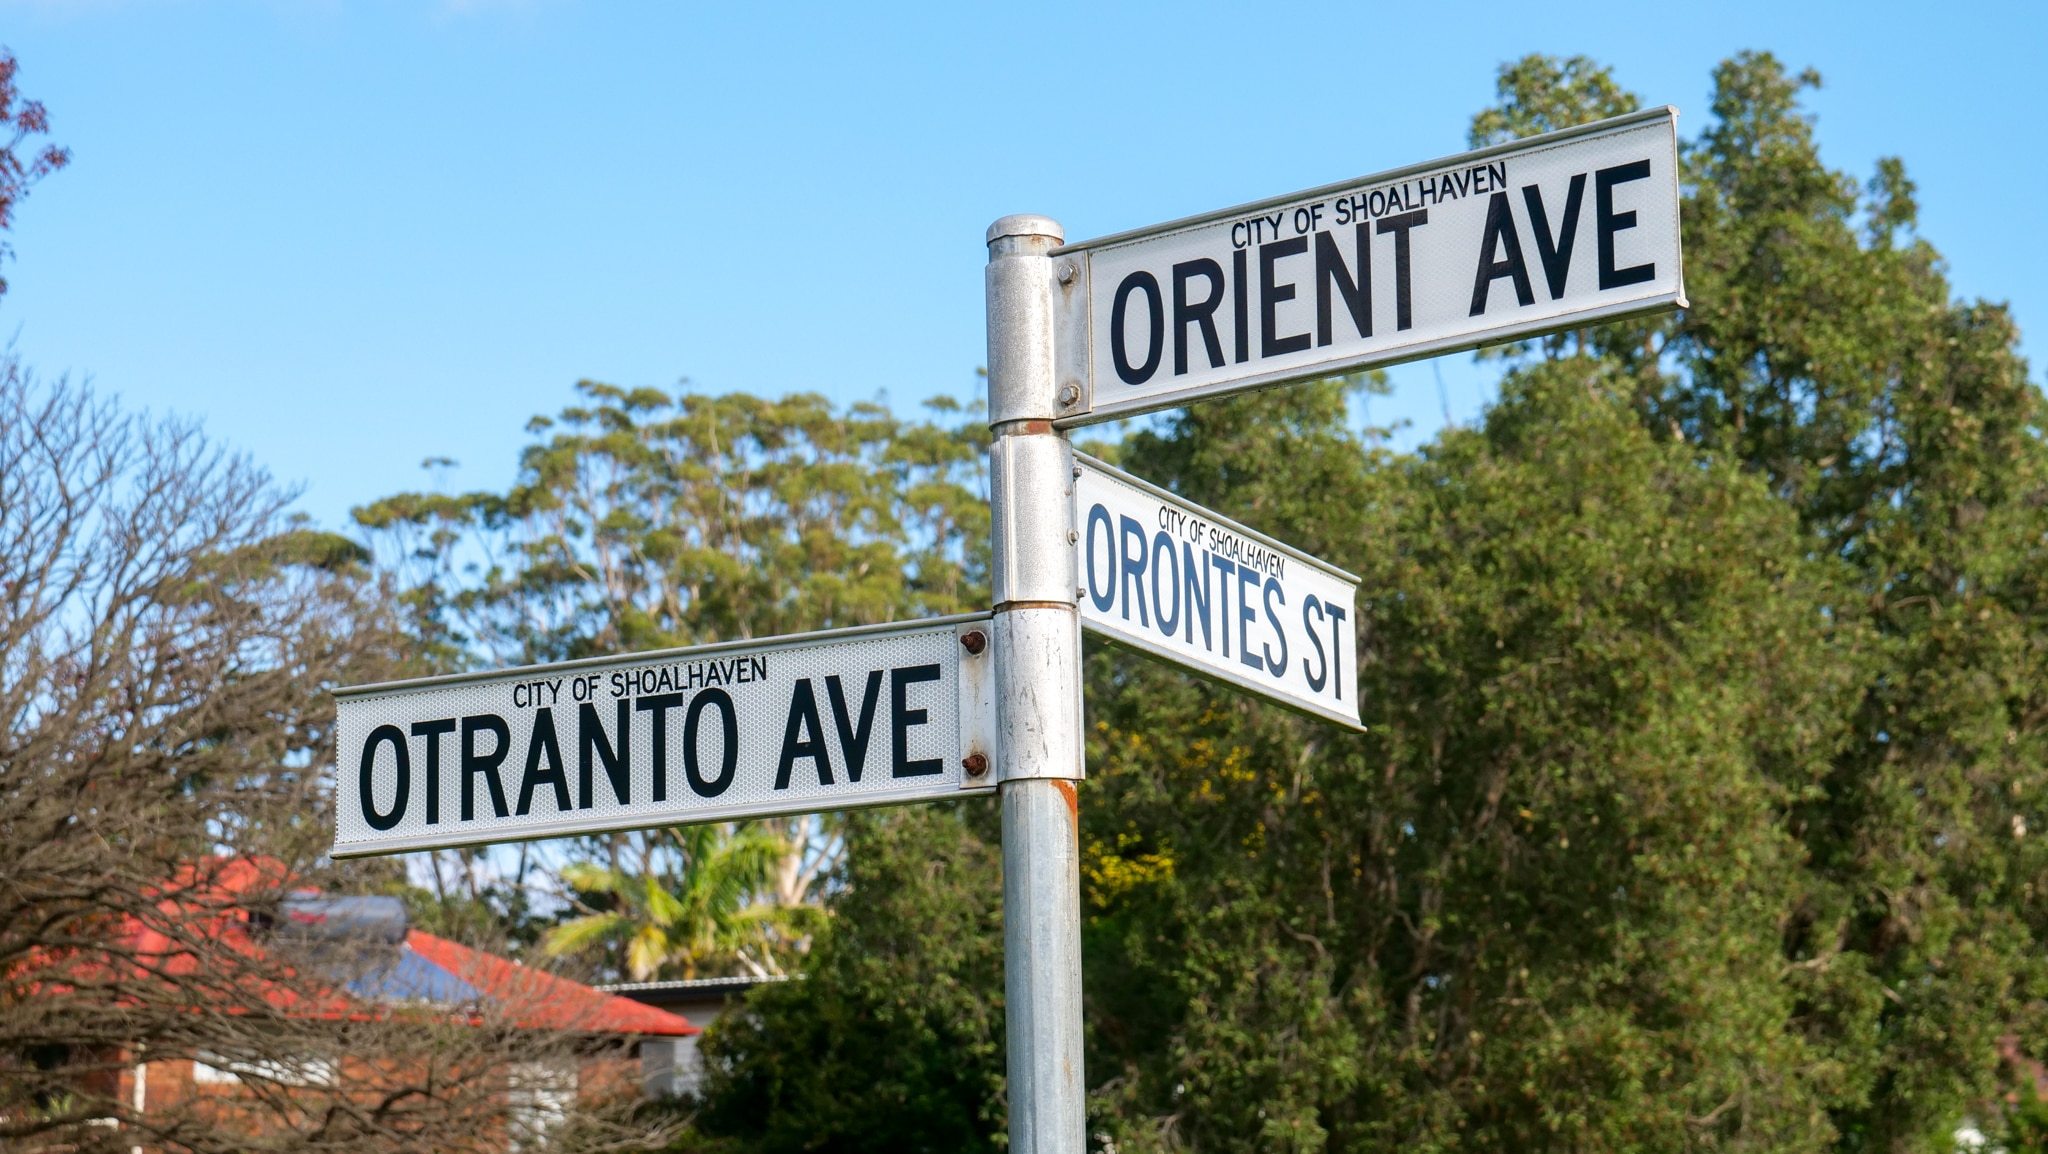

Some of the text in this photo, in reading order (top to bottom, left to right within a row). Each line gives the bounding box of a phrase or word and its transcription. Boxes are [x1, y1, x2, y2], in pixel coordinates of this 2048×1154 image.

[1231, 162, 1507, 249] CITY OF SHOALHAVEN
[1111, 158, 1656, 386] ORIENT AVE
[1086, 503, 1346, 701] ORONTES ST
[1158, 505, 1285, 581] CITY OF SHOALHAVEN
[513, 656, 767, 709] CITY OF SHOALHAVEN
[359, 663, 943, 831] OTRANTO AVE
